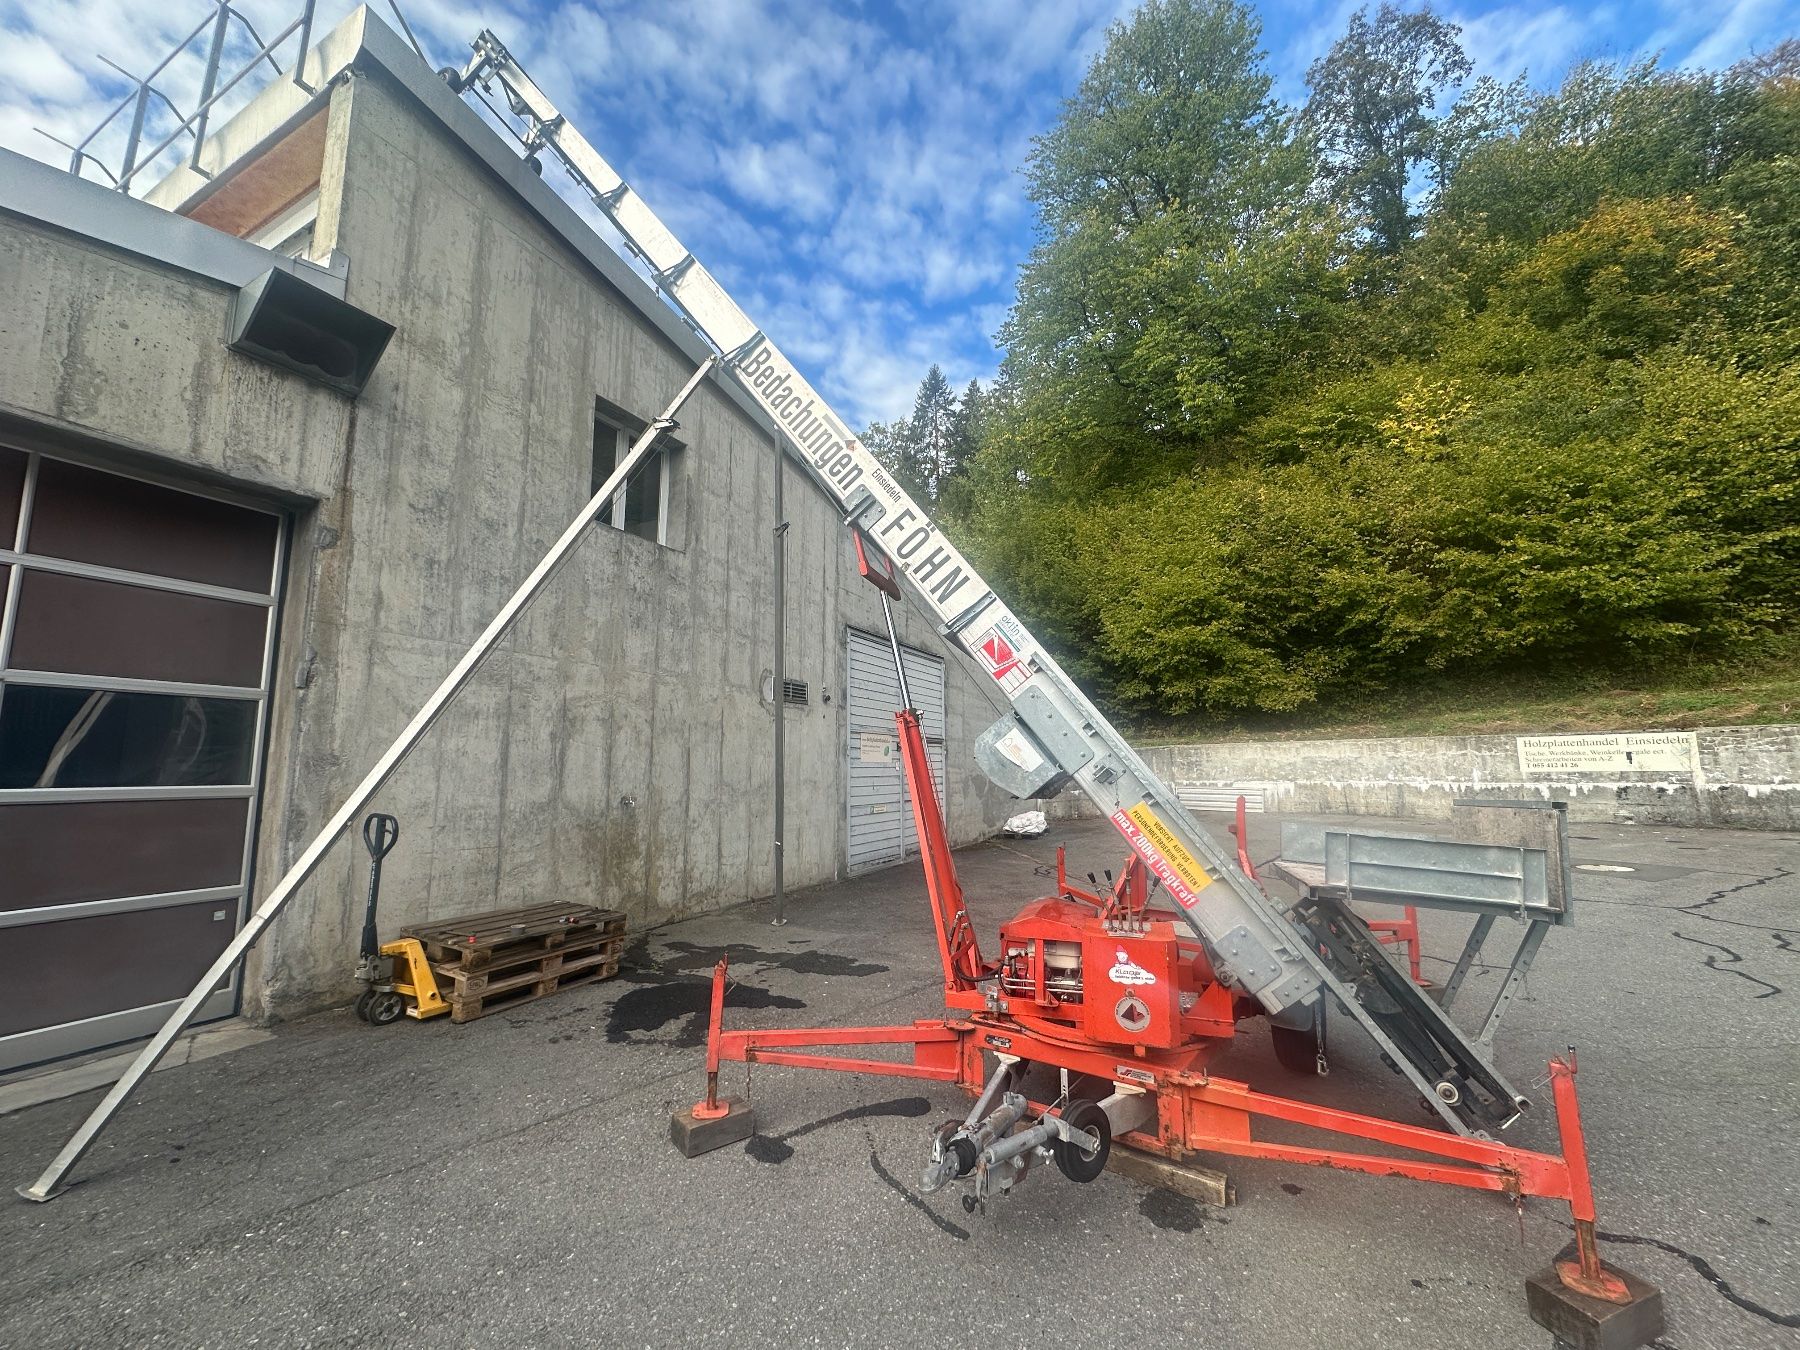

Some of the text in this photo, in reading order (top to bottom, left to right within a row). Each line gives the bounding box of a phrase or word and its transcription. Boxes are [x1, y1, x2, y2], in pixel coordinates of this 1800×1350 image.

[744, 347, 863, 491] Bedachungen
[871, 467, 902, 504] Einsiedeln
[880, 508, 970, 605] FÖHN
[1523, 735, 1688, 749] Holzplattenhandel Einsiedeln
[1113, 811, 1197, 905] max. 200kg Tragkraft
[1153, 821, 1174, 844] VORSICHT
